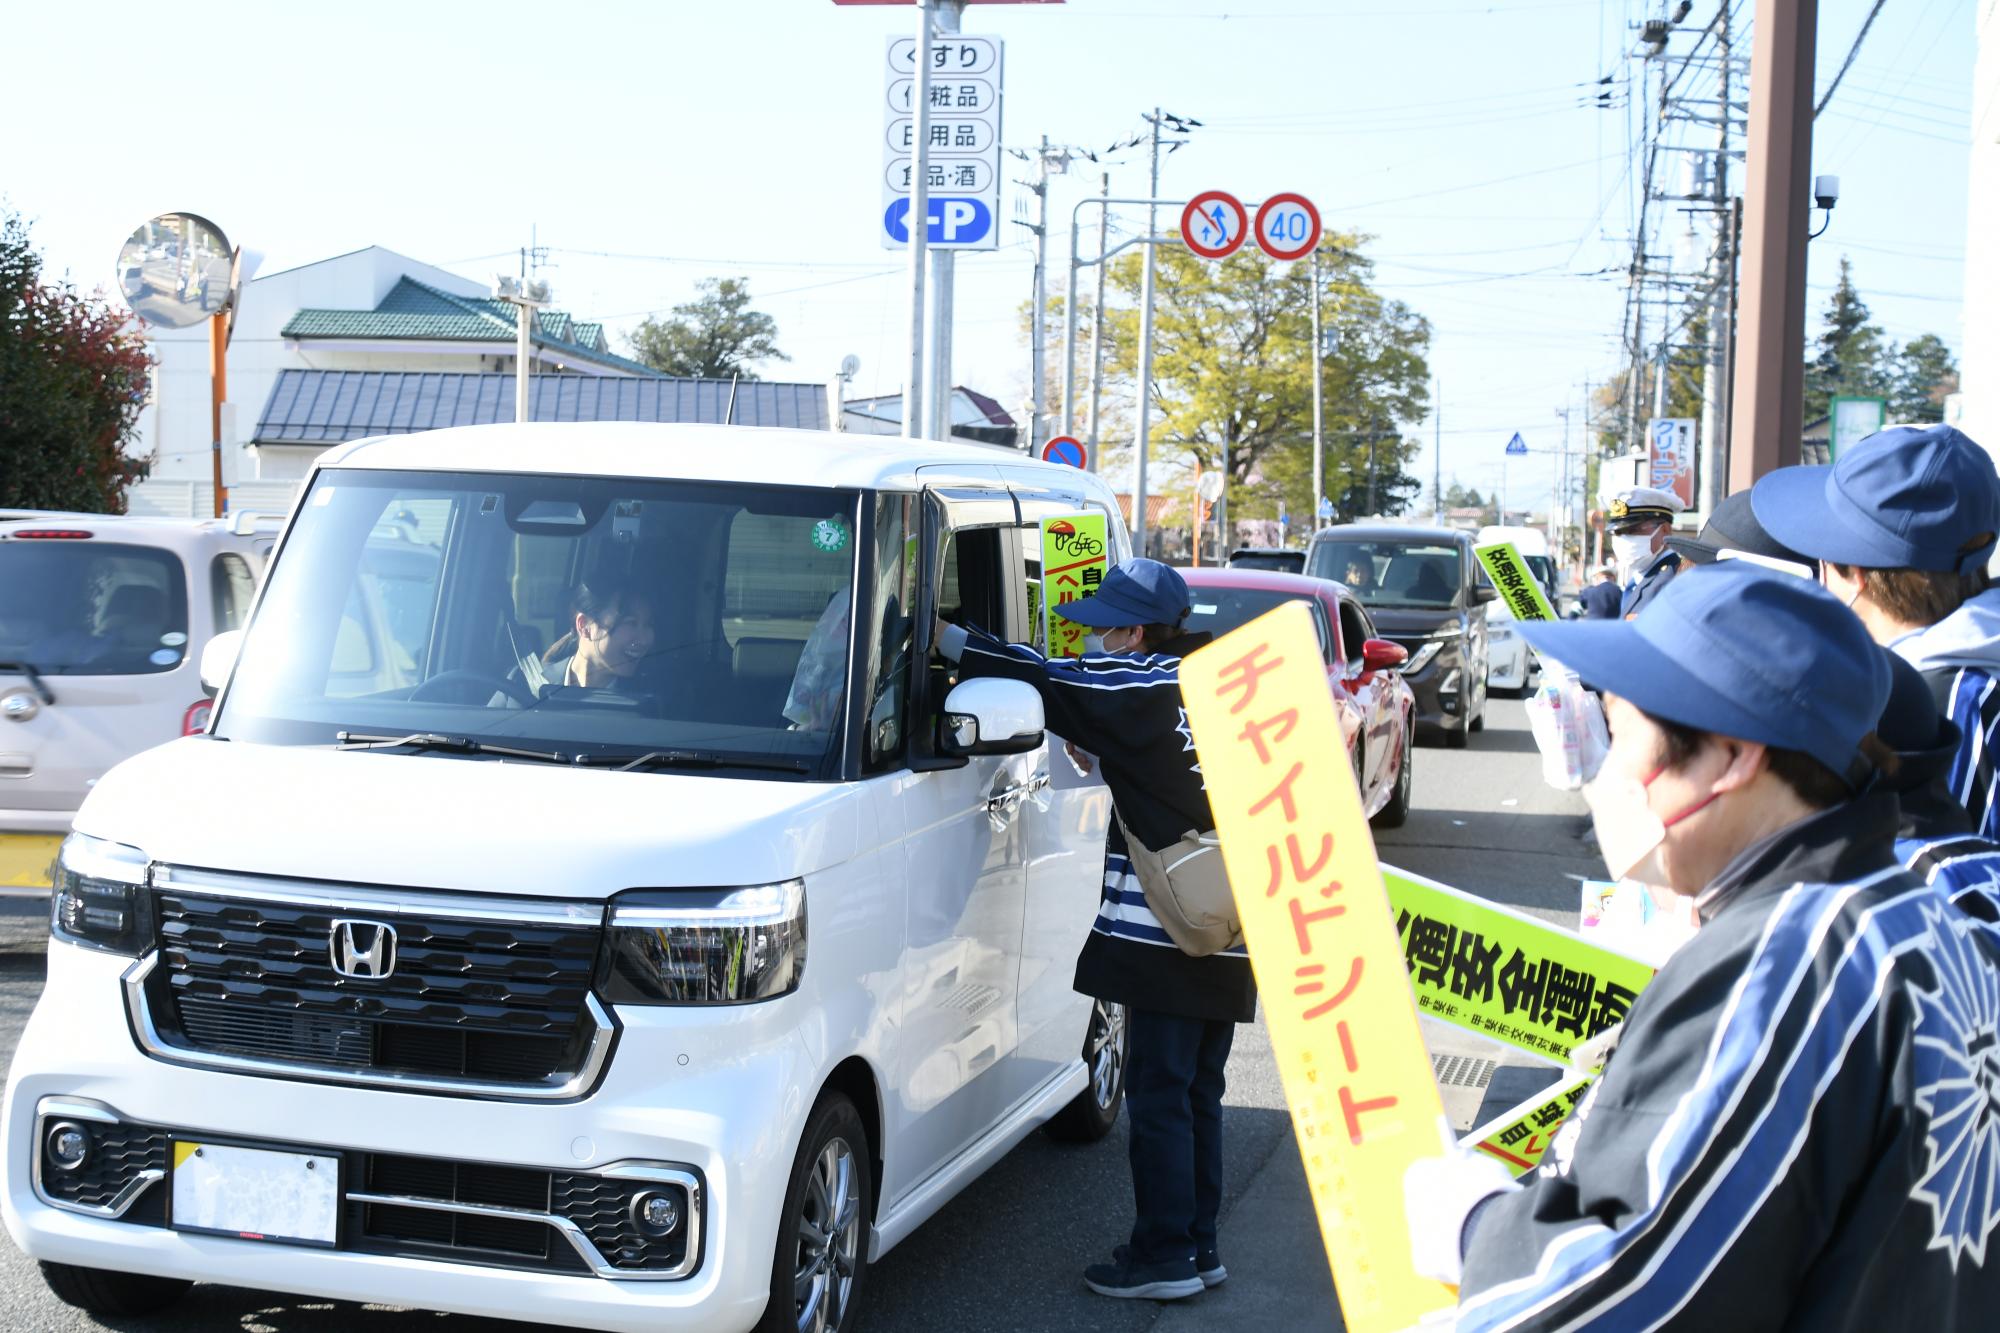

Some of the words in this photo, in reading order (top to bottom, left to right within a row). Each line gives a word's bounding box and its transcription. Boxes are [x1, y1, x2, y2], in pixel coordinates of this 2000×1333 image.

[943, 201, 976, 241] P
[1269, 212, 1306, 241] 40
[1655, 421, 1675, 493] クリーニン
[1215, 642, 1398, 1145] チャイルドシート
[1393, 907, 1640, 1041] 通安全運動
